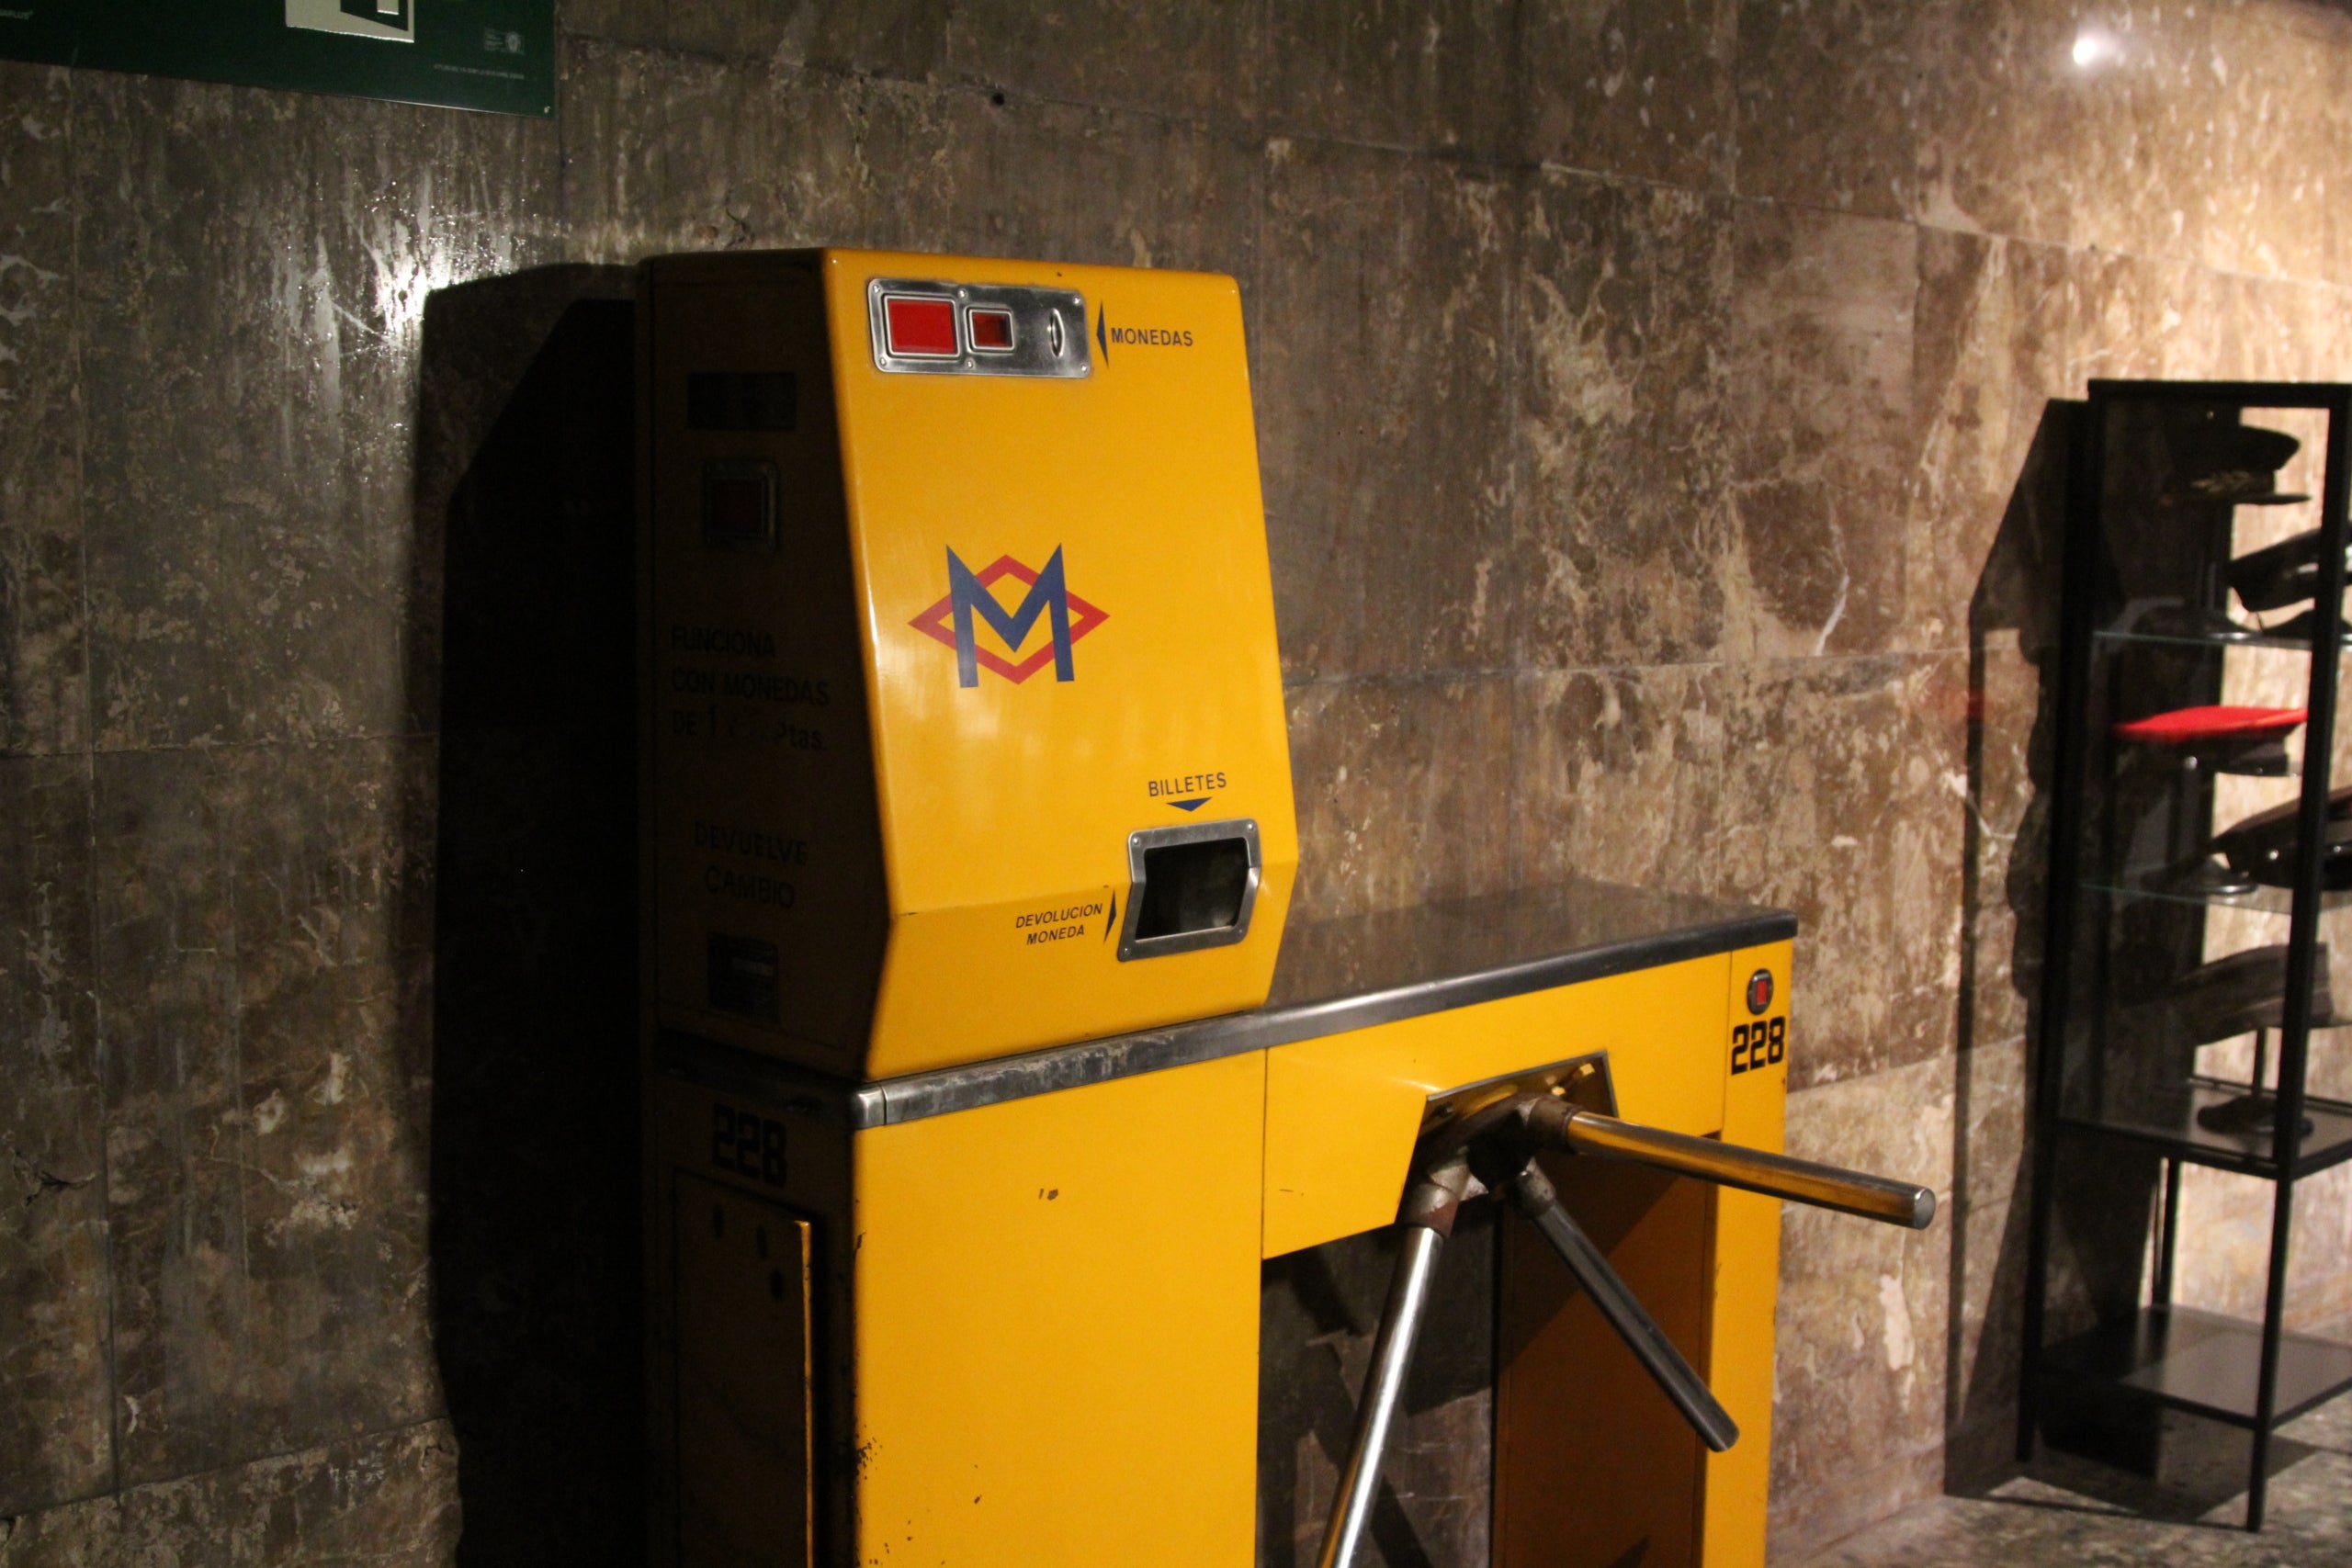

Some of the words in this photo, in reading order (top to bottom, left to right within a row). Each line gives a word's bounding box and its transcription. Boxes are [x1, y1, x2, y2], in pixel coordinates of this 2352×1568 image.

[1111, 327, 1193, 346] MONEDAS
[671, 625, 775, 657] FUNCIONA
[672, 666, 714, 694] CON
[724, 672, 830, 706] MONEDAS
[672, 709, 697, 736] DE
[1148, 772, 1227, 796] BILLETES
[693, 820, 808, 865] DEVUELVE
[705, 865, 796, 908] CAMBIO
[1015, 903, 1102, 929] DEVOLUCION
[1026, 924, 1085, 945] MONEDA
[1731, 1015, 1785, 1076] 228
[713, 1102, 788, 1189] 228
